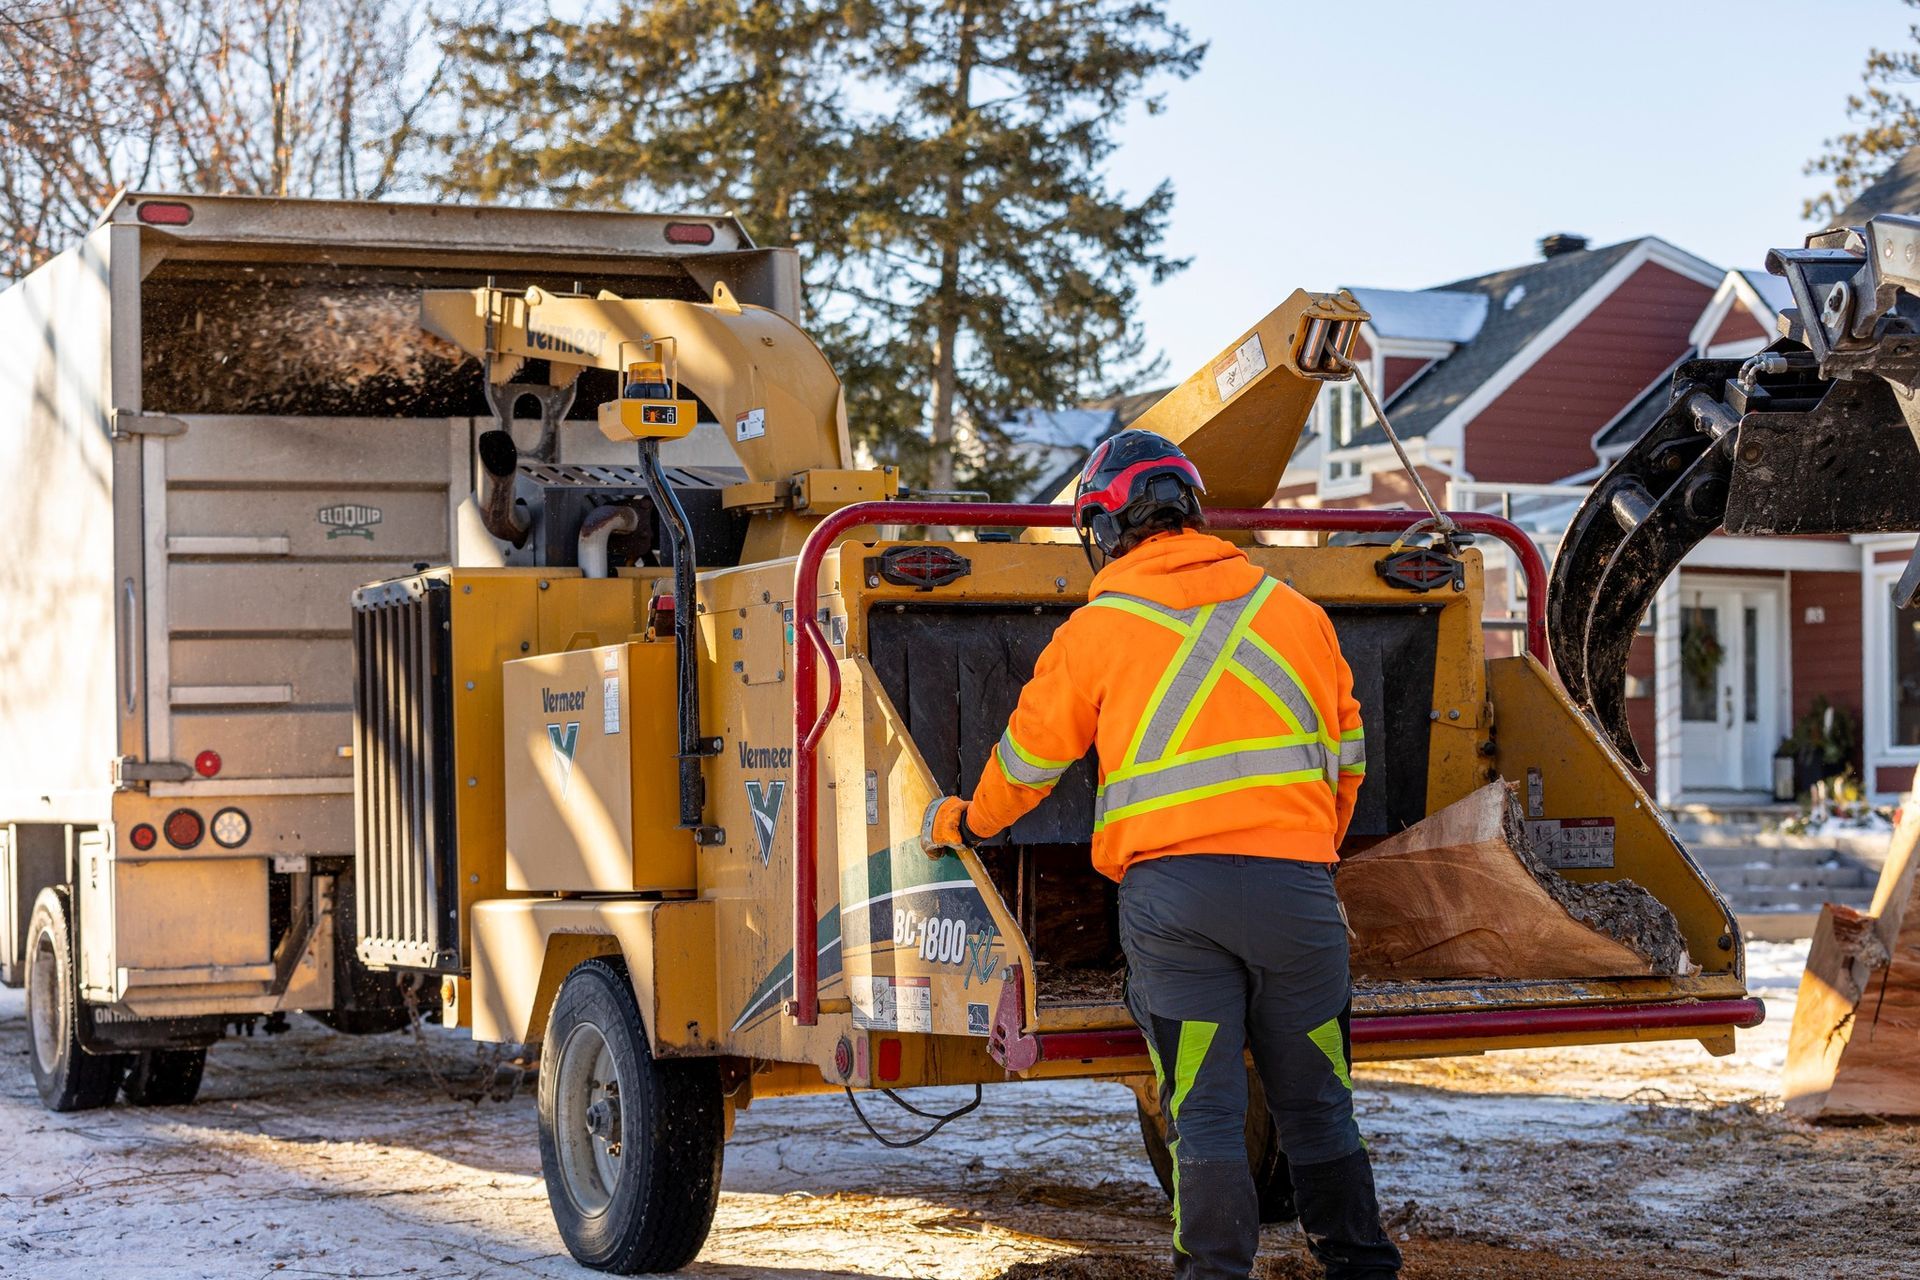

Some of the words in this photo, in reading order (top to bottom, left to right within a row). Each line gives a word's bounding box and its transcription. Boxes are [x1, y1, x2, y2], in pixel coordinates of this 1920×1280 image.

[526, 311, 607, 357] Vermeer
[320, 506, 380, 527] ELOQUIP
[542, 687, 586, 713] Vermeer
[738, 741, 793, 769] Vermeer
